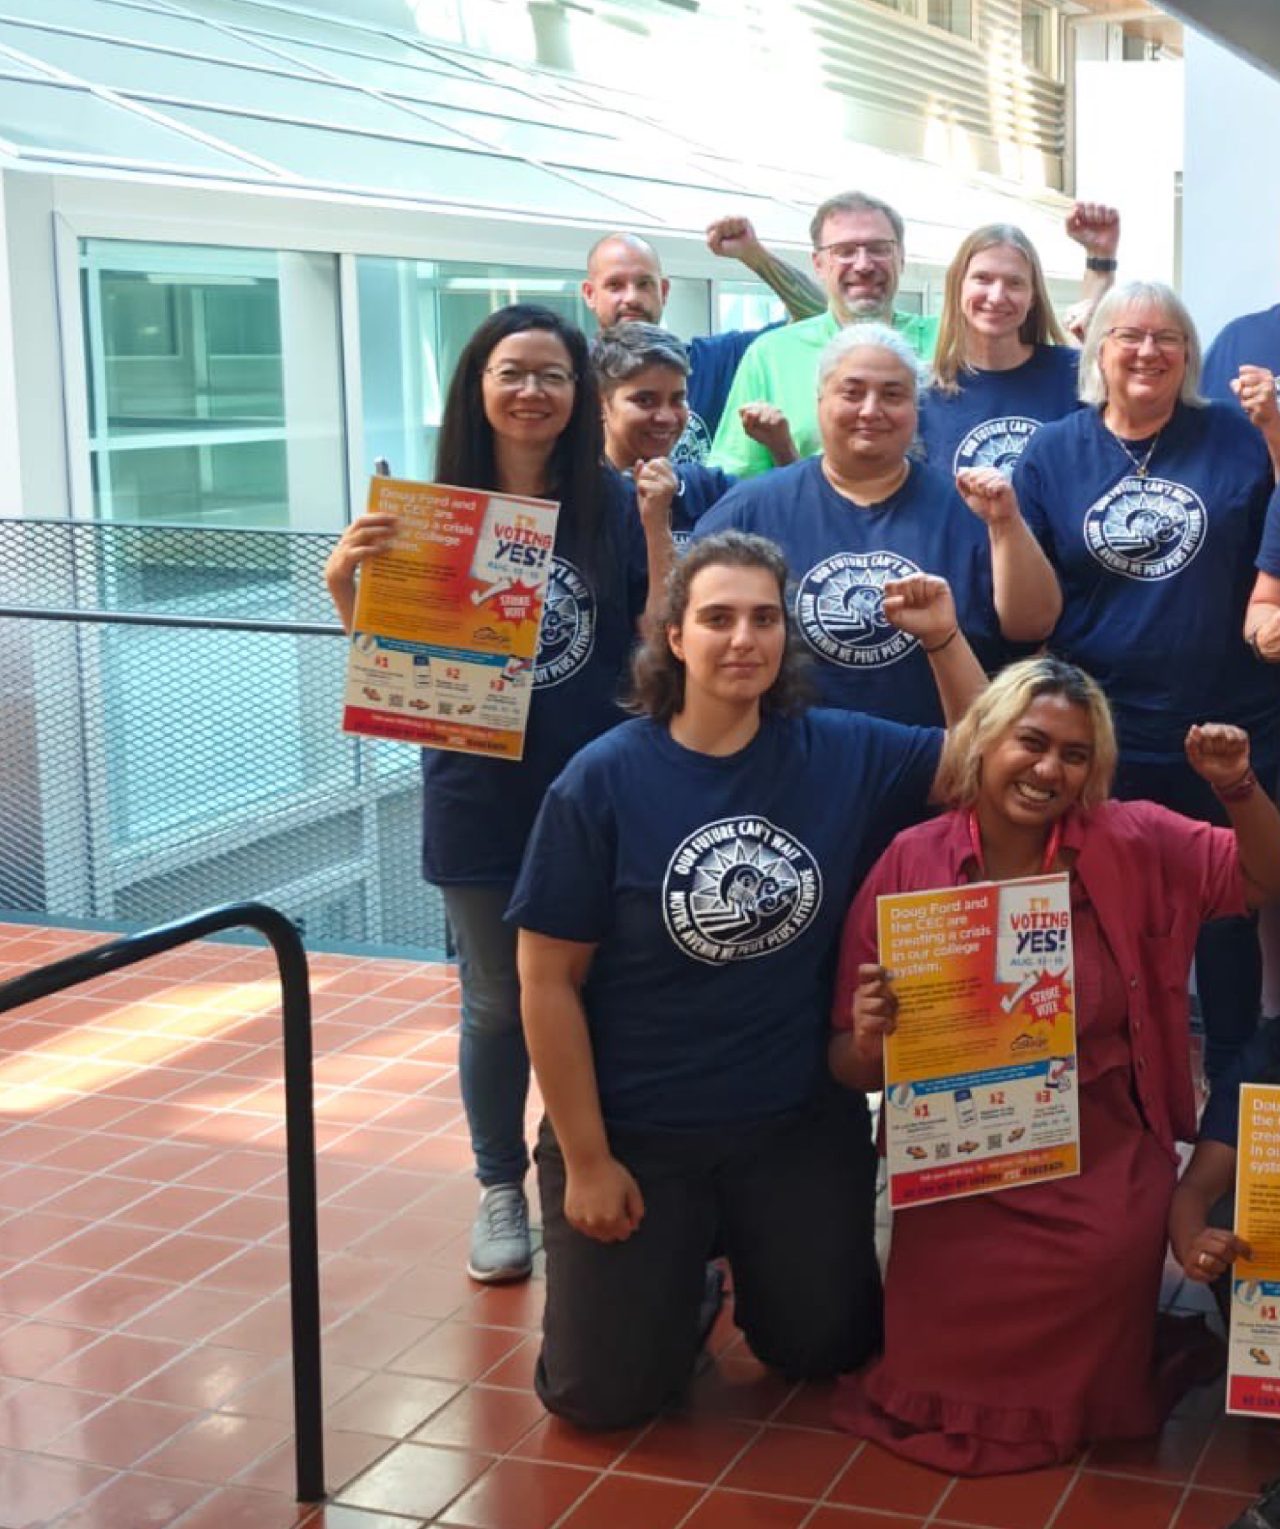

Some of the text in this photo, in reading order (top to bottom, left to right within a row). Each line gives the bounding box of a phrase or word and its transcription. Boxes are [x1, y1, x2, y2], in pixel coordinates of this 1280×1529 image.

[1109, 481, 1142, 497] FUTURE
[1171, 487, 1194, 503] WAIT
[494, 522, 552, 549] VOTING
[495, 540, 547, 569] YES!
[829, 556, 868, 570] FUTURE
[881, 637, 906, 659] PLUS
[674, 821, 802, 876] OUR FUTURE CAN'T WAIT
[767, 923, 796, 947] PLUS
[795, 868, 815, 926] ATTENDRE
[890, 896, 988, 919] Doug Ford and
[947, 915, 967, 926] are
[960, 924, 991, 938] crisis
[1010, 911, 1069, 930] VOTING
[933, 942, 980, 956] college
[1016, 929, 1067, 955] YES!
[1030, 985, 1061, 1005] STRIKE
[1035, 1001, 1058, 1018] VOTE
[1253, 1114, 1273, 1126] the
